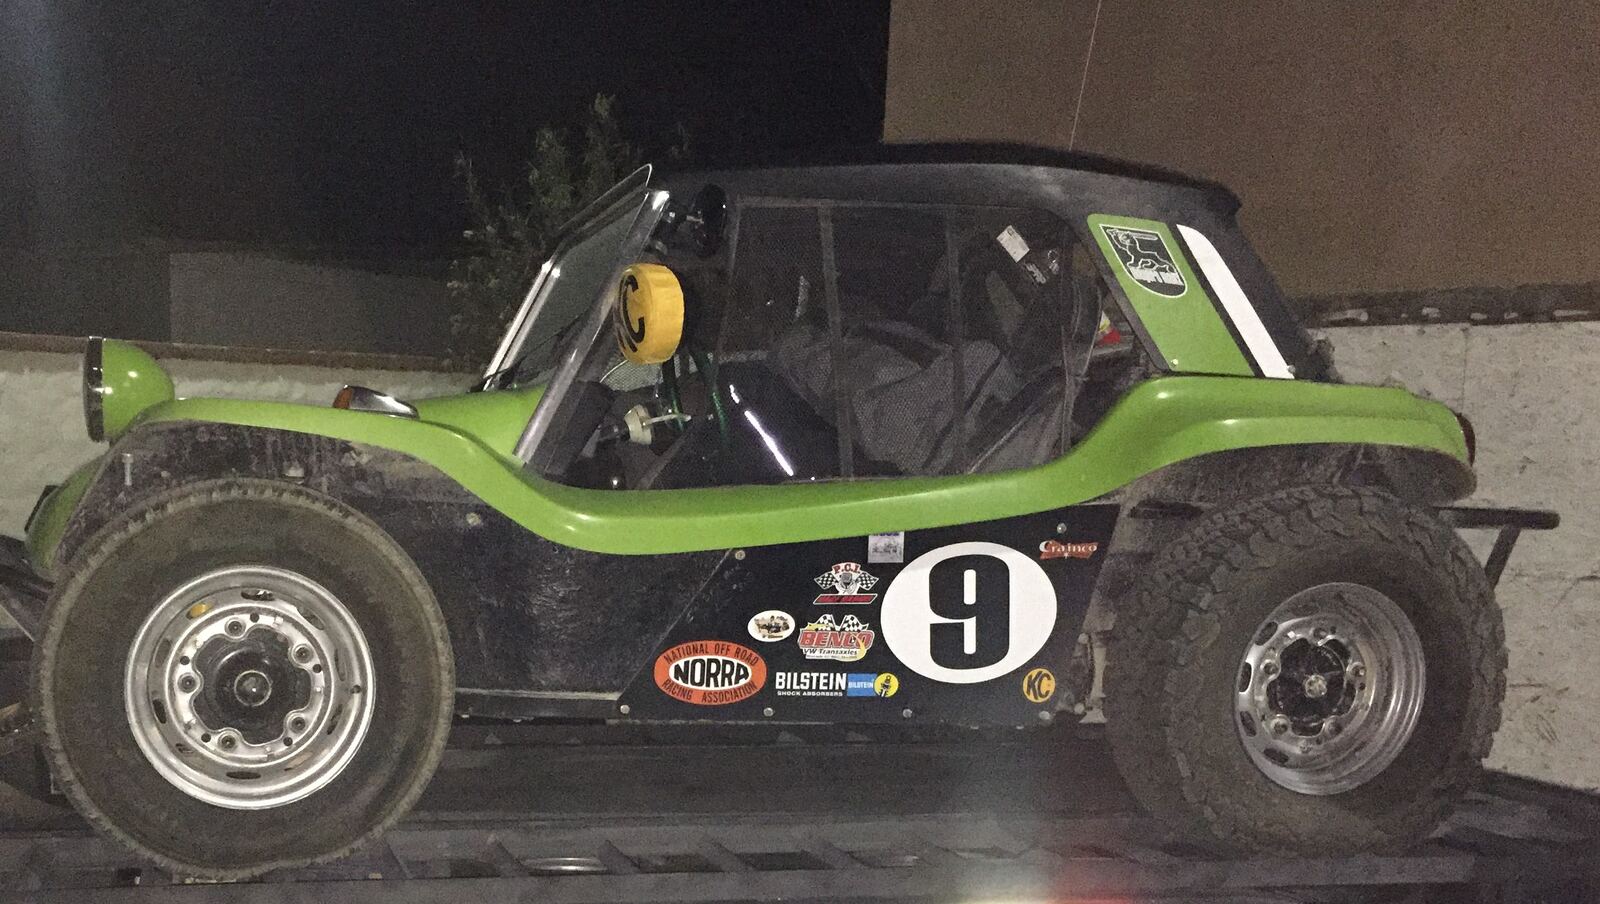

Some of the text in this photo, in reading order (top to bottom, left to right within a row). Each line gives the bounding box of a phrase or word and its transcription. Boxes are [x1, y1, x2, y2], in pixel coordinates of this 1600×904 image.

[929, 554, 1010, 670] 9
[800, 630, 874, 649] BENCO
[664, 642, 759, 666] NATIONAL OFF ROAD
[673, 657, 750, 688] NORRA
[775, 672, 847, 690] BILSTEIN
[662, 679, 758, 703] RACING ASSOCIATION
[848, 681, 875, 689] BILSTEIN
[1026, 671, 1051, 701] KC
